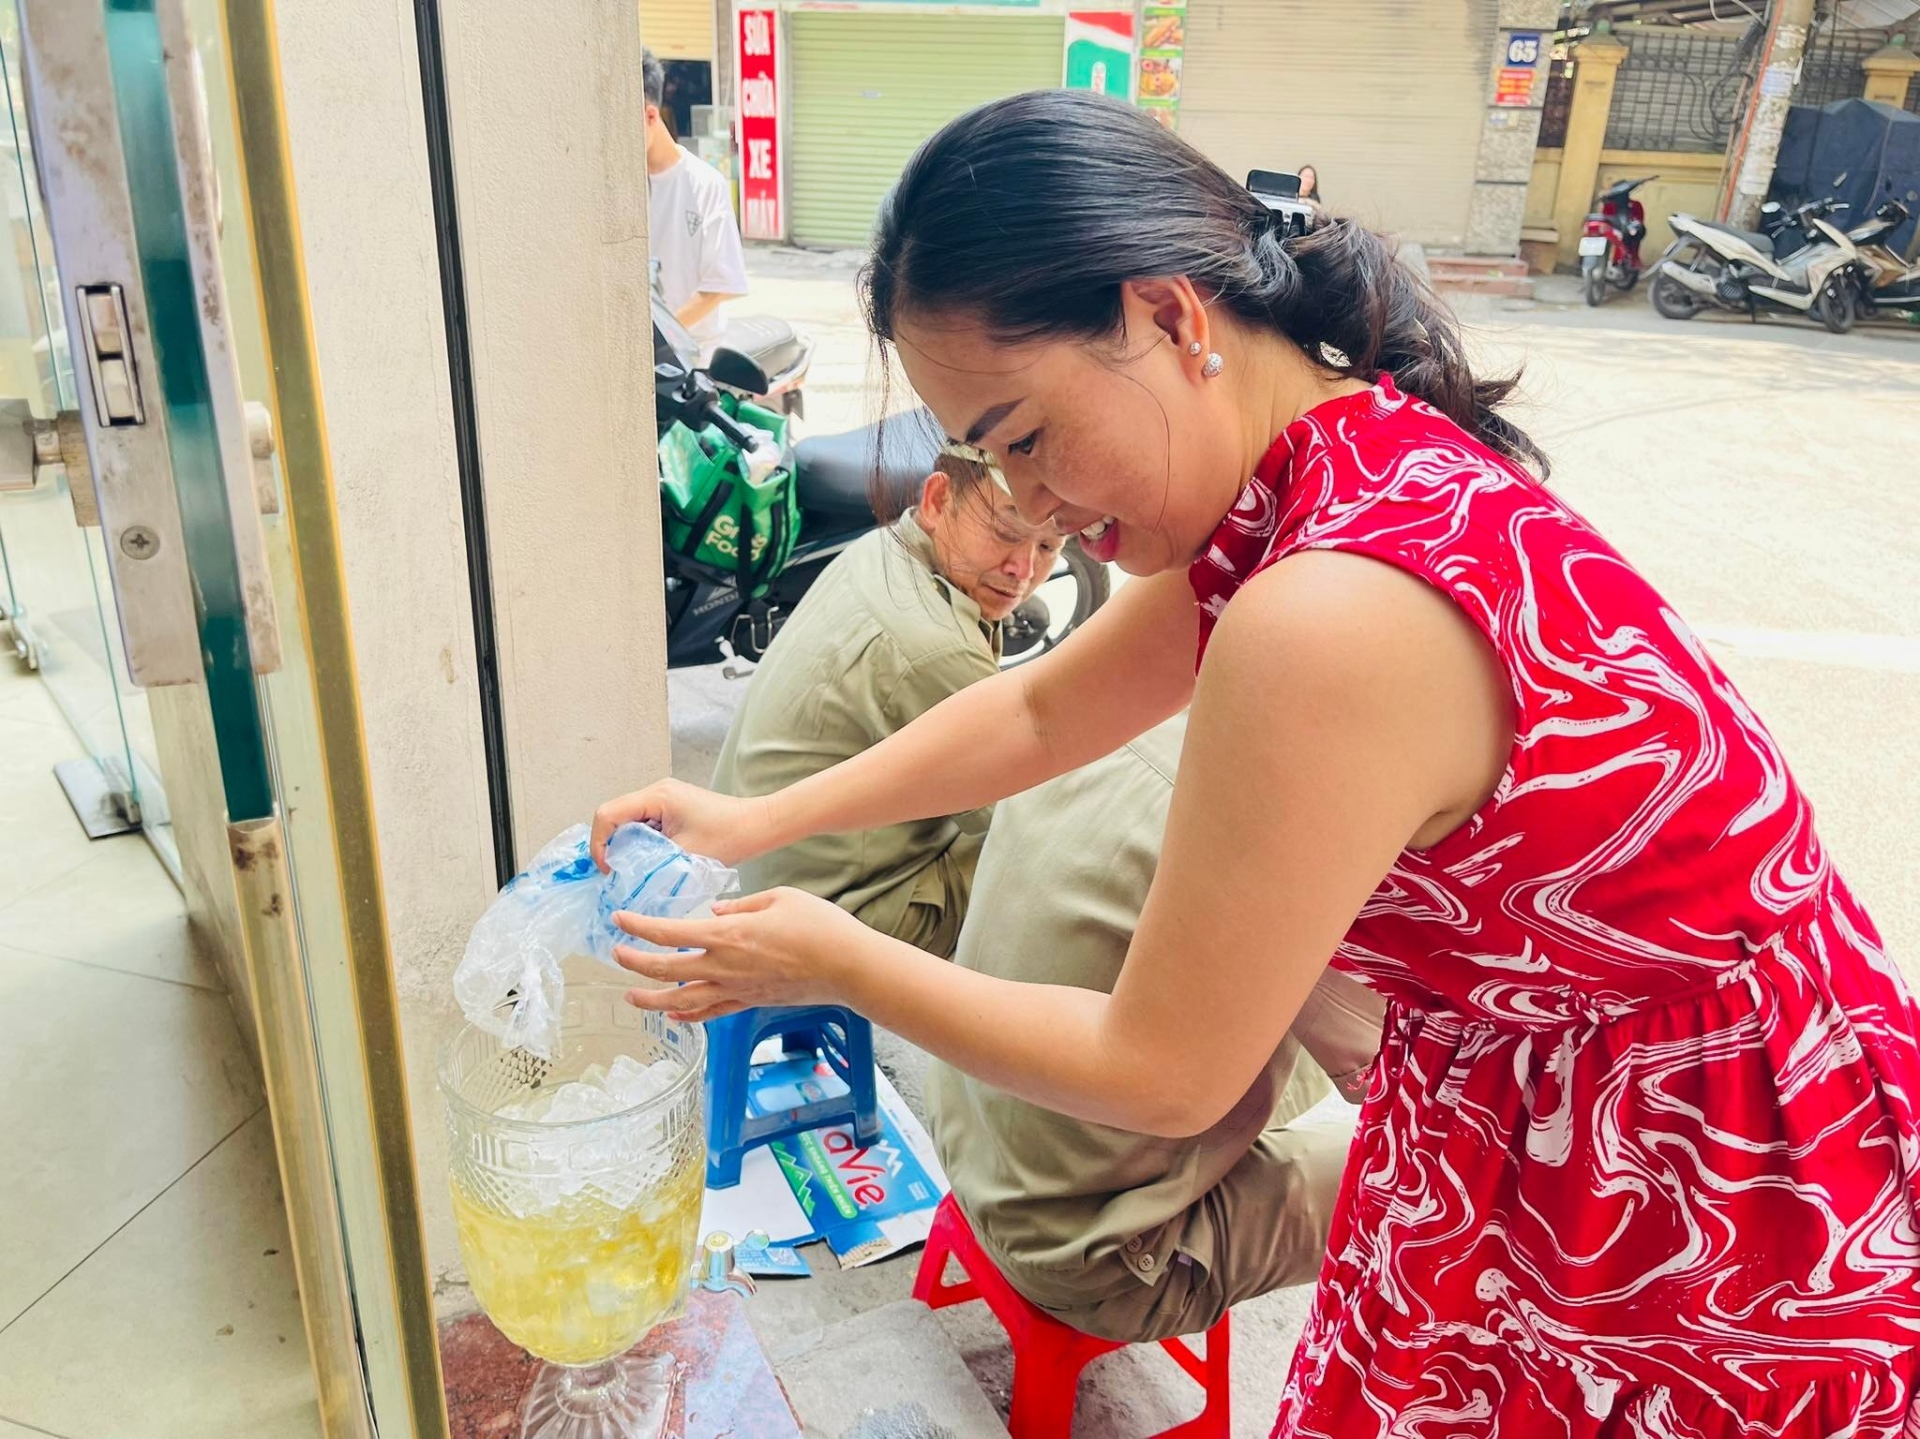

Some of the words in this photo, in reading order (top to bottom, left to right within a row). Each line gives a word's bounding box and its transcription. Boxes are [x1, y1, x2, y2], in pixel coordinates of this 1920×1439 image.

[1509, 39, 1538, 63] 65
[748, 138, 772, 179] XE
[714, 514, 768, 549] Grb
[693, 591, 739, 616] HOND
[818, 1126, 886, 1206] aVie
